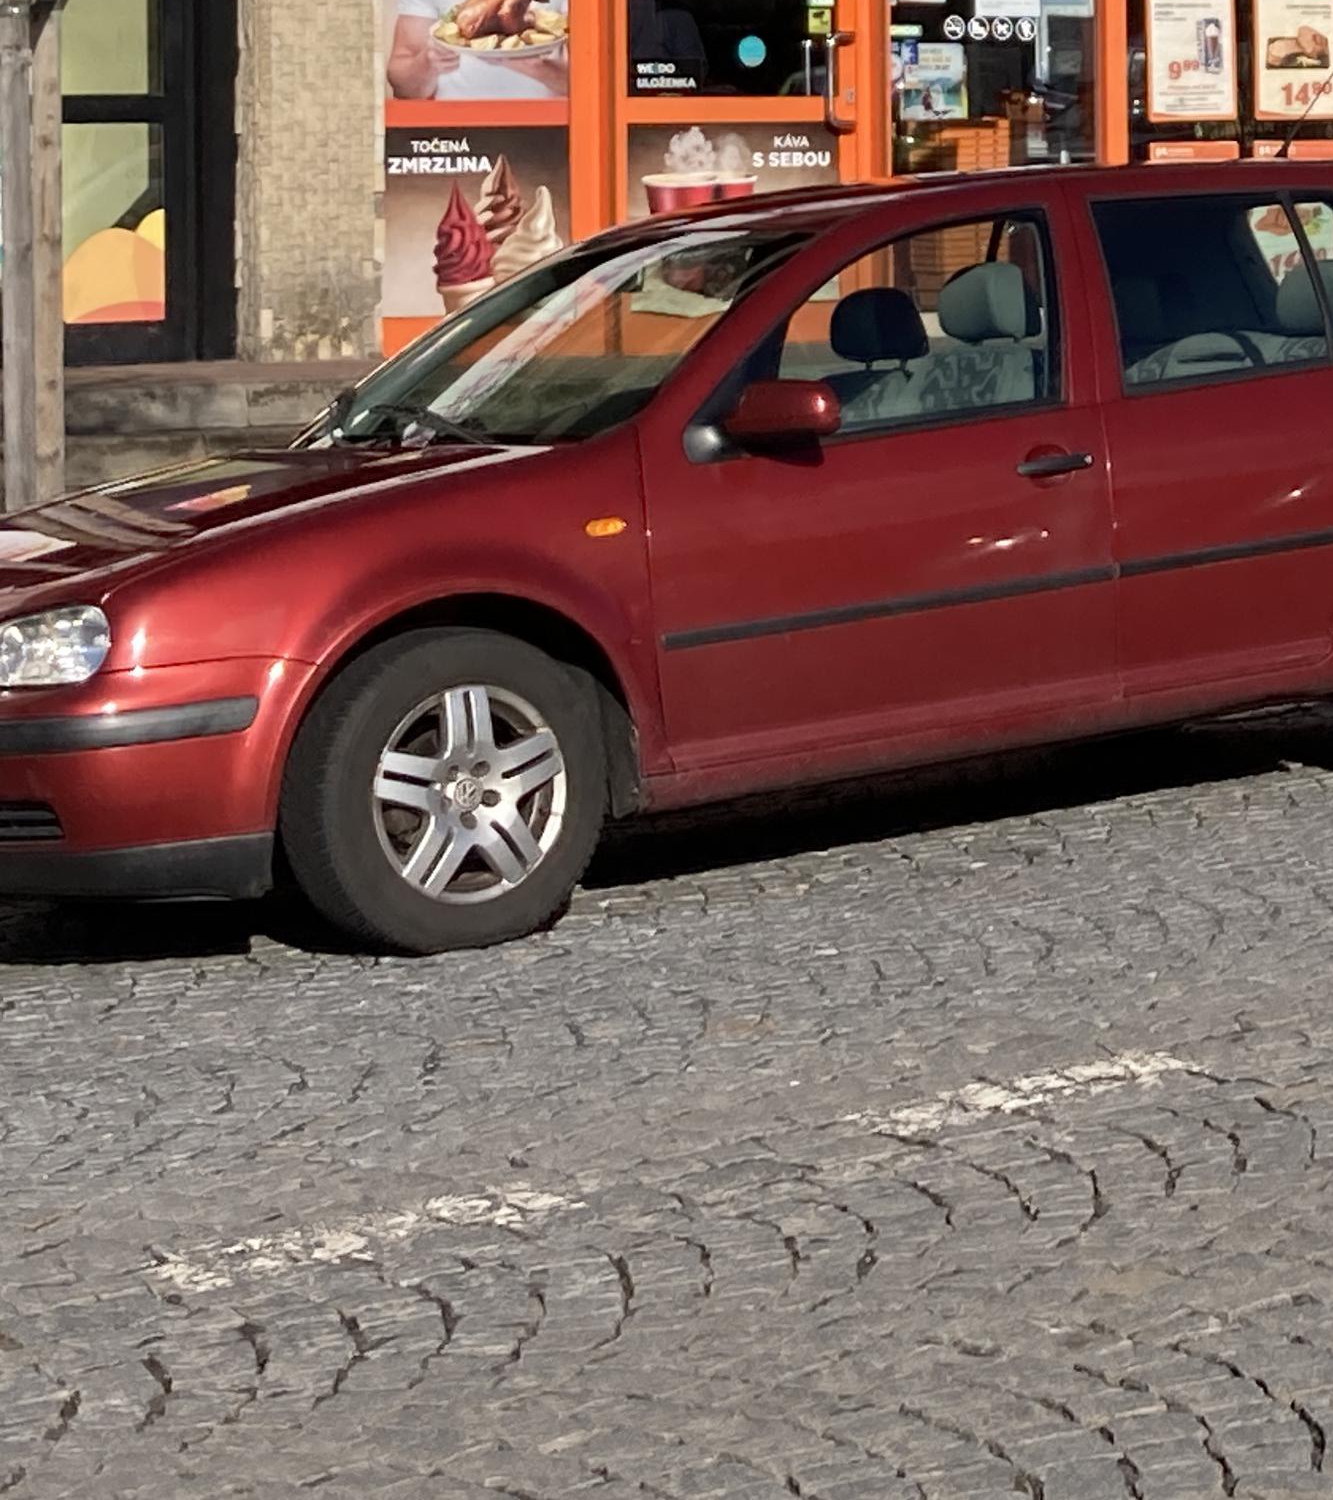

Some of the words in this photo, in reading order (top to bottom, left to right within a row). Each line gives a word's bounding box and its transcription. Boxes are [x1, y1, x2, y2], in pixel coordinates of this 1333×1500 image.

[410, 136, 470, 154] TOČENÁ
[773, 133, 810, 149] KÁVA
[387, 155, 493, 174] ZMRZLINA
[752, 151, 765, 167] S
[768, 151, 831, 167] SEBOU
